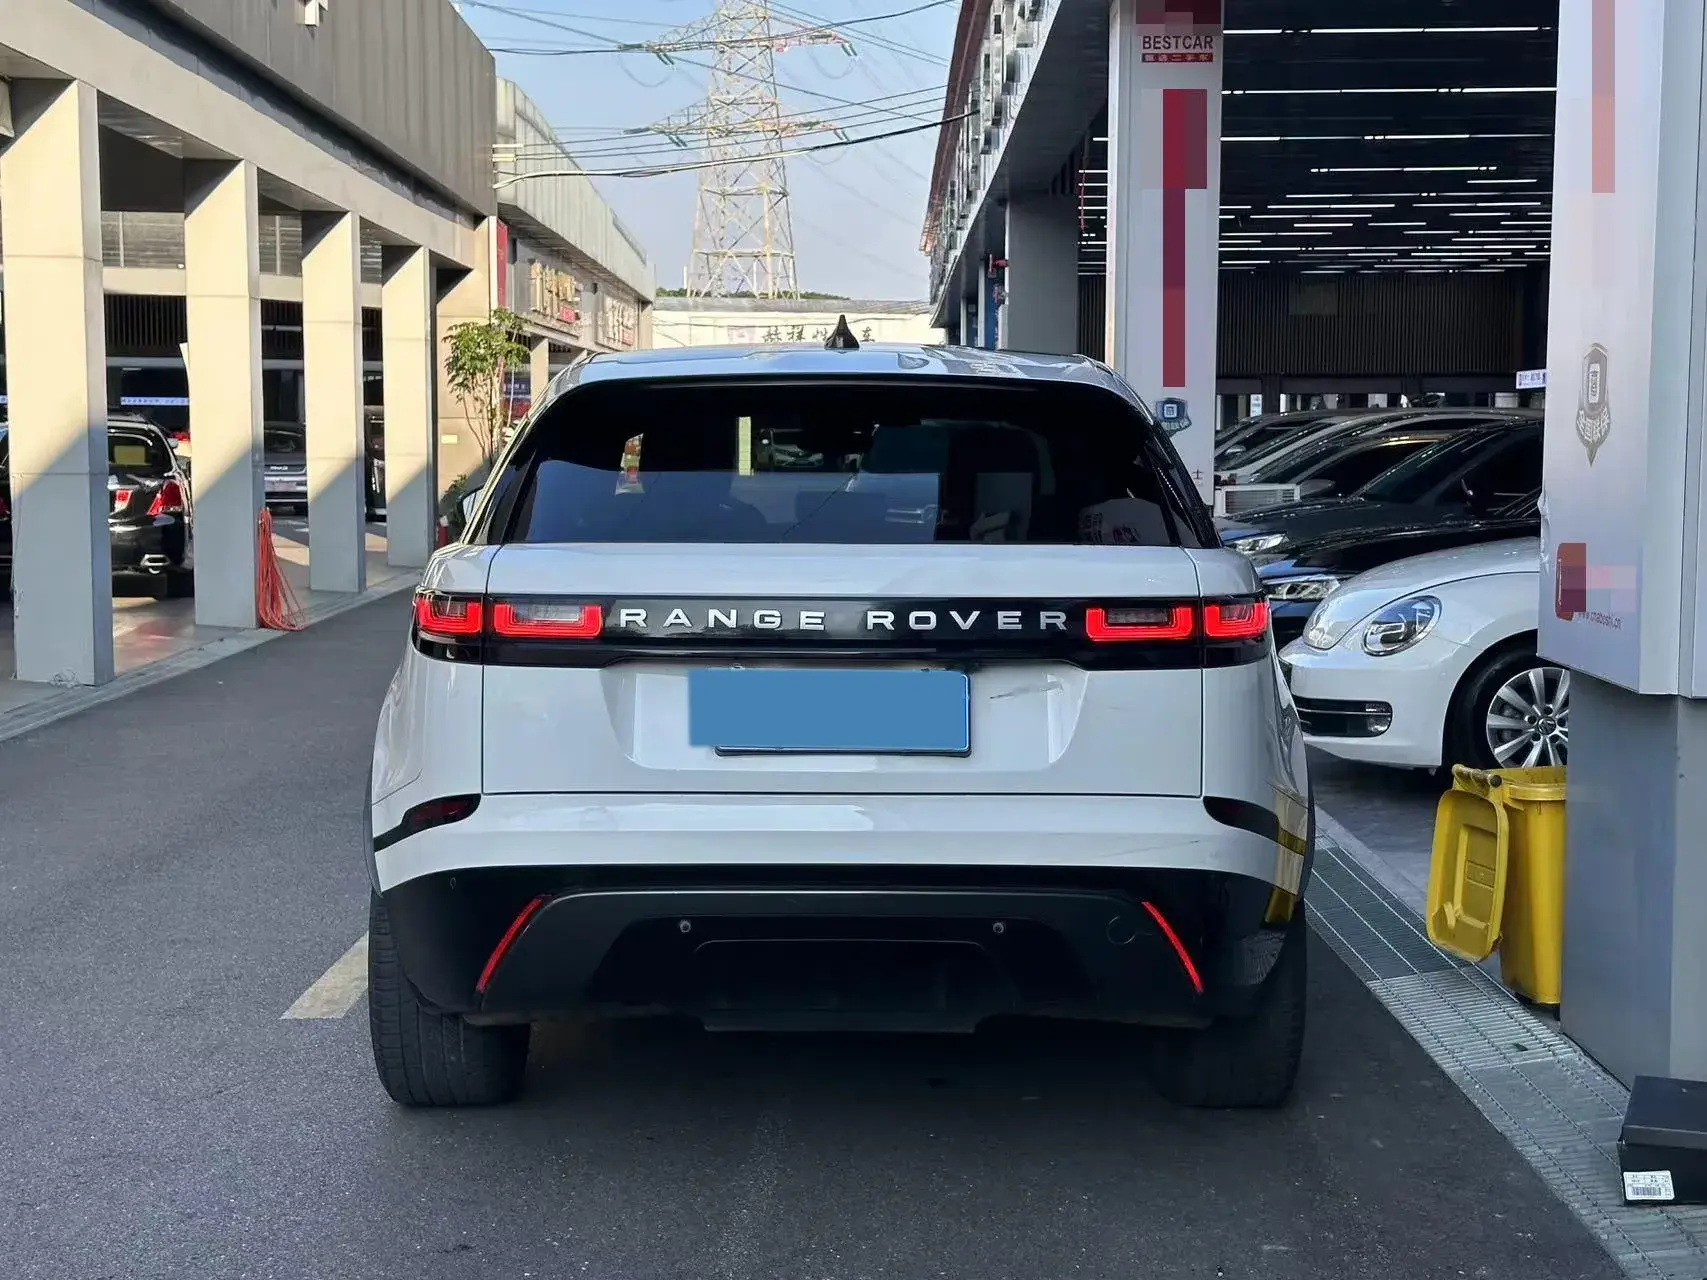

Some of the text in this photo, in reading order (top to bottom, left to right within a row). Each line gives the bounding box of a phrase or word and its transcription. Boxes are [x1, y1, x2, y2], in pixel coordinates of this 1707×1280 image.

[1142, 35, 1214, 50] BESTCAR
[619, 607, 1069, 632] RANGE ROVER
